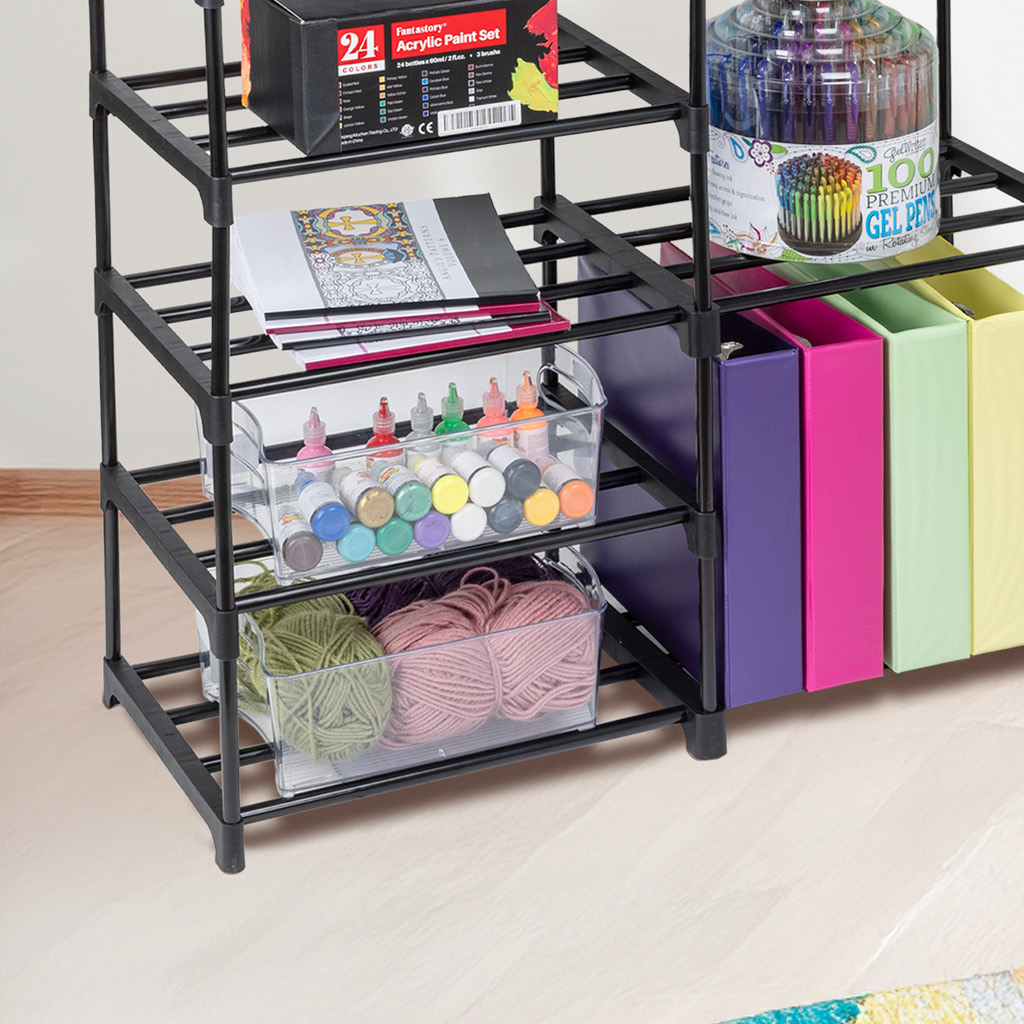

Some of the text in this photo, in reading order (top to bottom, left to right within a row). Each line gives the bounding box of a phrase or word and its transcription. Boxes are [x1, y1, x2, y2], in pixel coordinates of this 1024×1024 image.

[340, 30, 379, 62] 24
[396, 28, 500, 52] Acrylic Paint Set
[342, 63, 378, 74] COLORS
[405, 59, 426, 68] bottles
[866, 147, 934, 194] 100
[866, 174, 936, 210] PREMIUM
[866, 206, 902, 239] GEL
[905, 189, 936, 232] PENS
